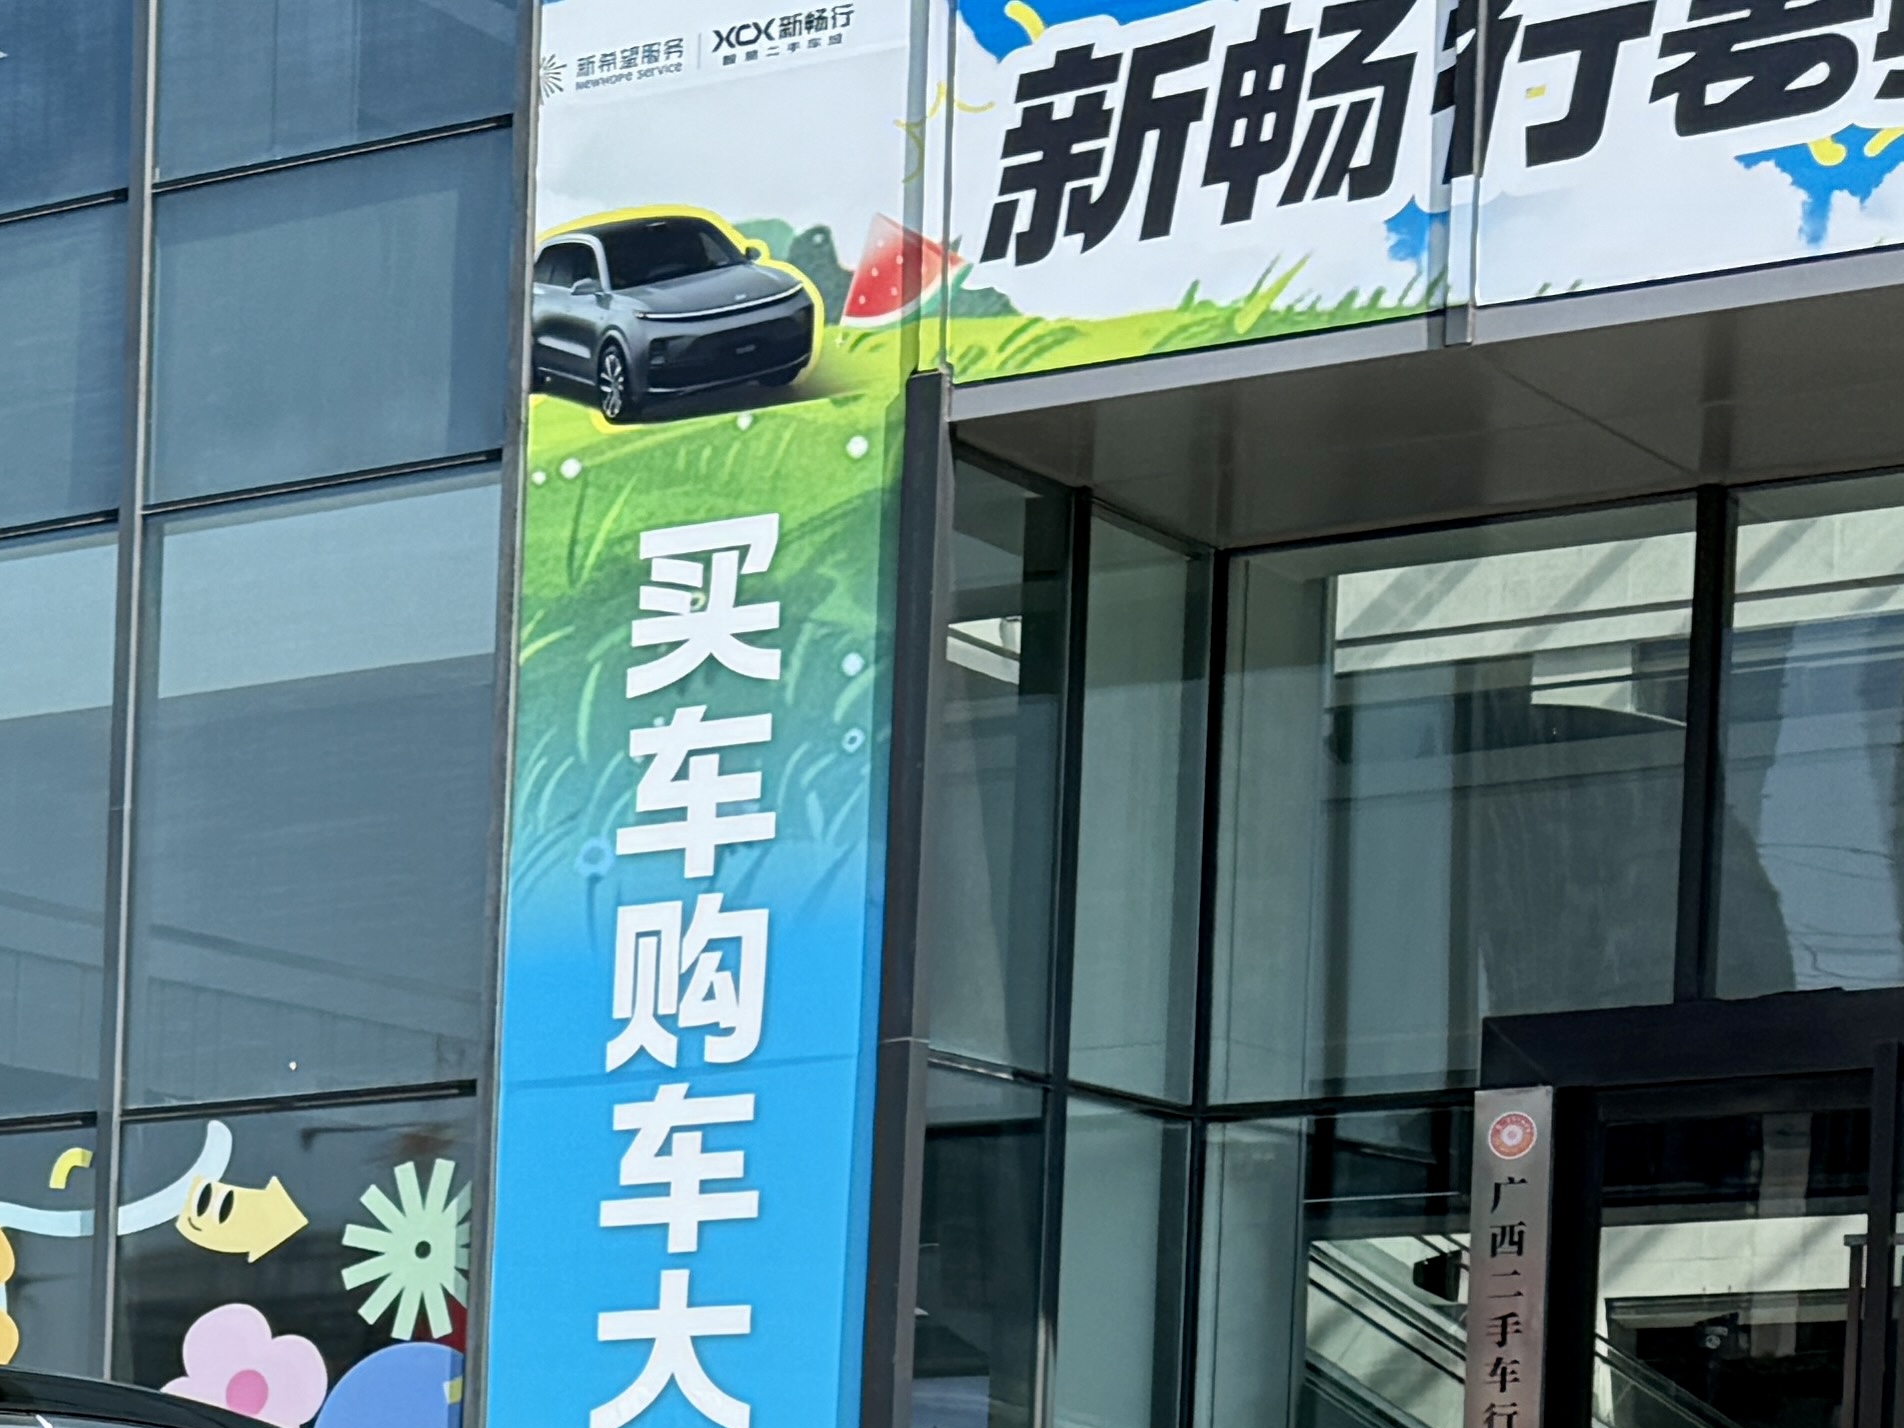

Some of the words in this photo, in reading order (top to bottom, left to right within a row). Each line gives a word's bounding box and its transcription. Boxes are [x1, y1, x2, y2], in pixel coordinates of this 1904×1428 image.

[576, 38, 684, 78] 新希望服务
[978, 0, 1904, 267] 新畅行暑
